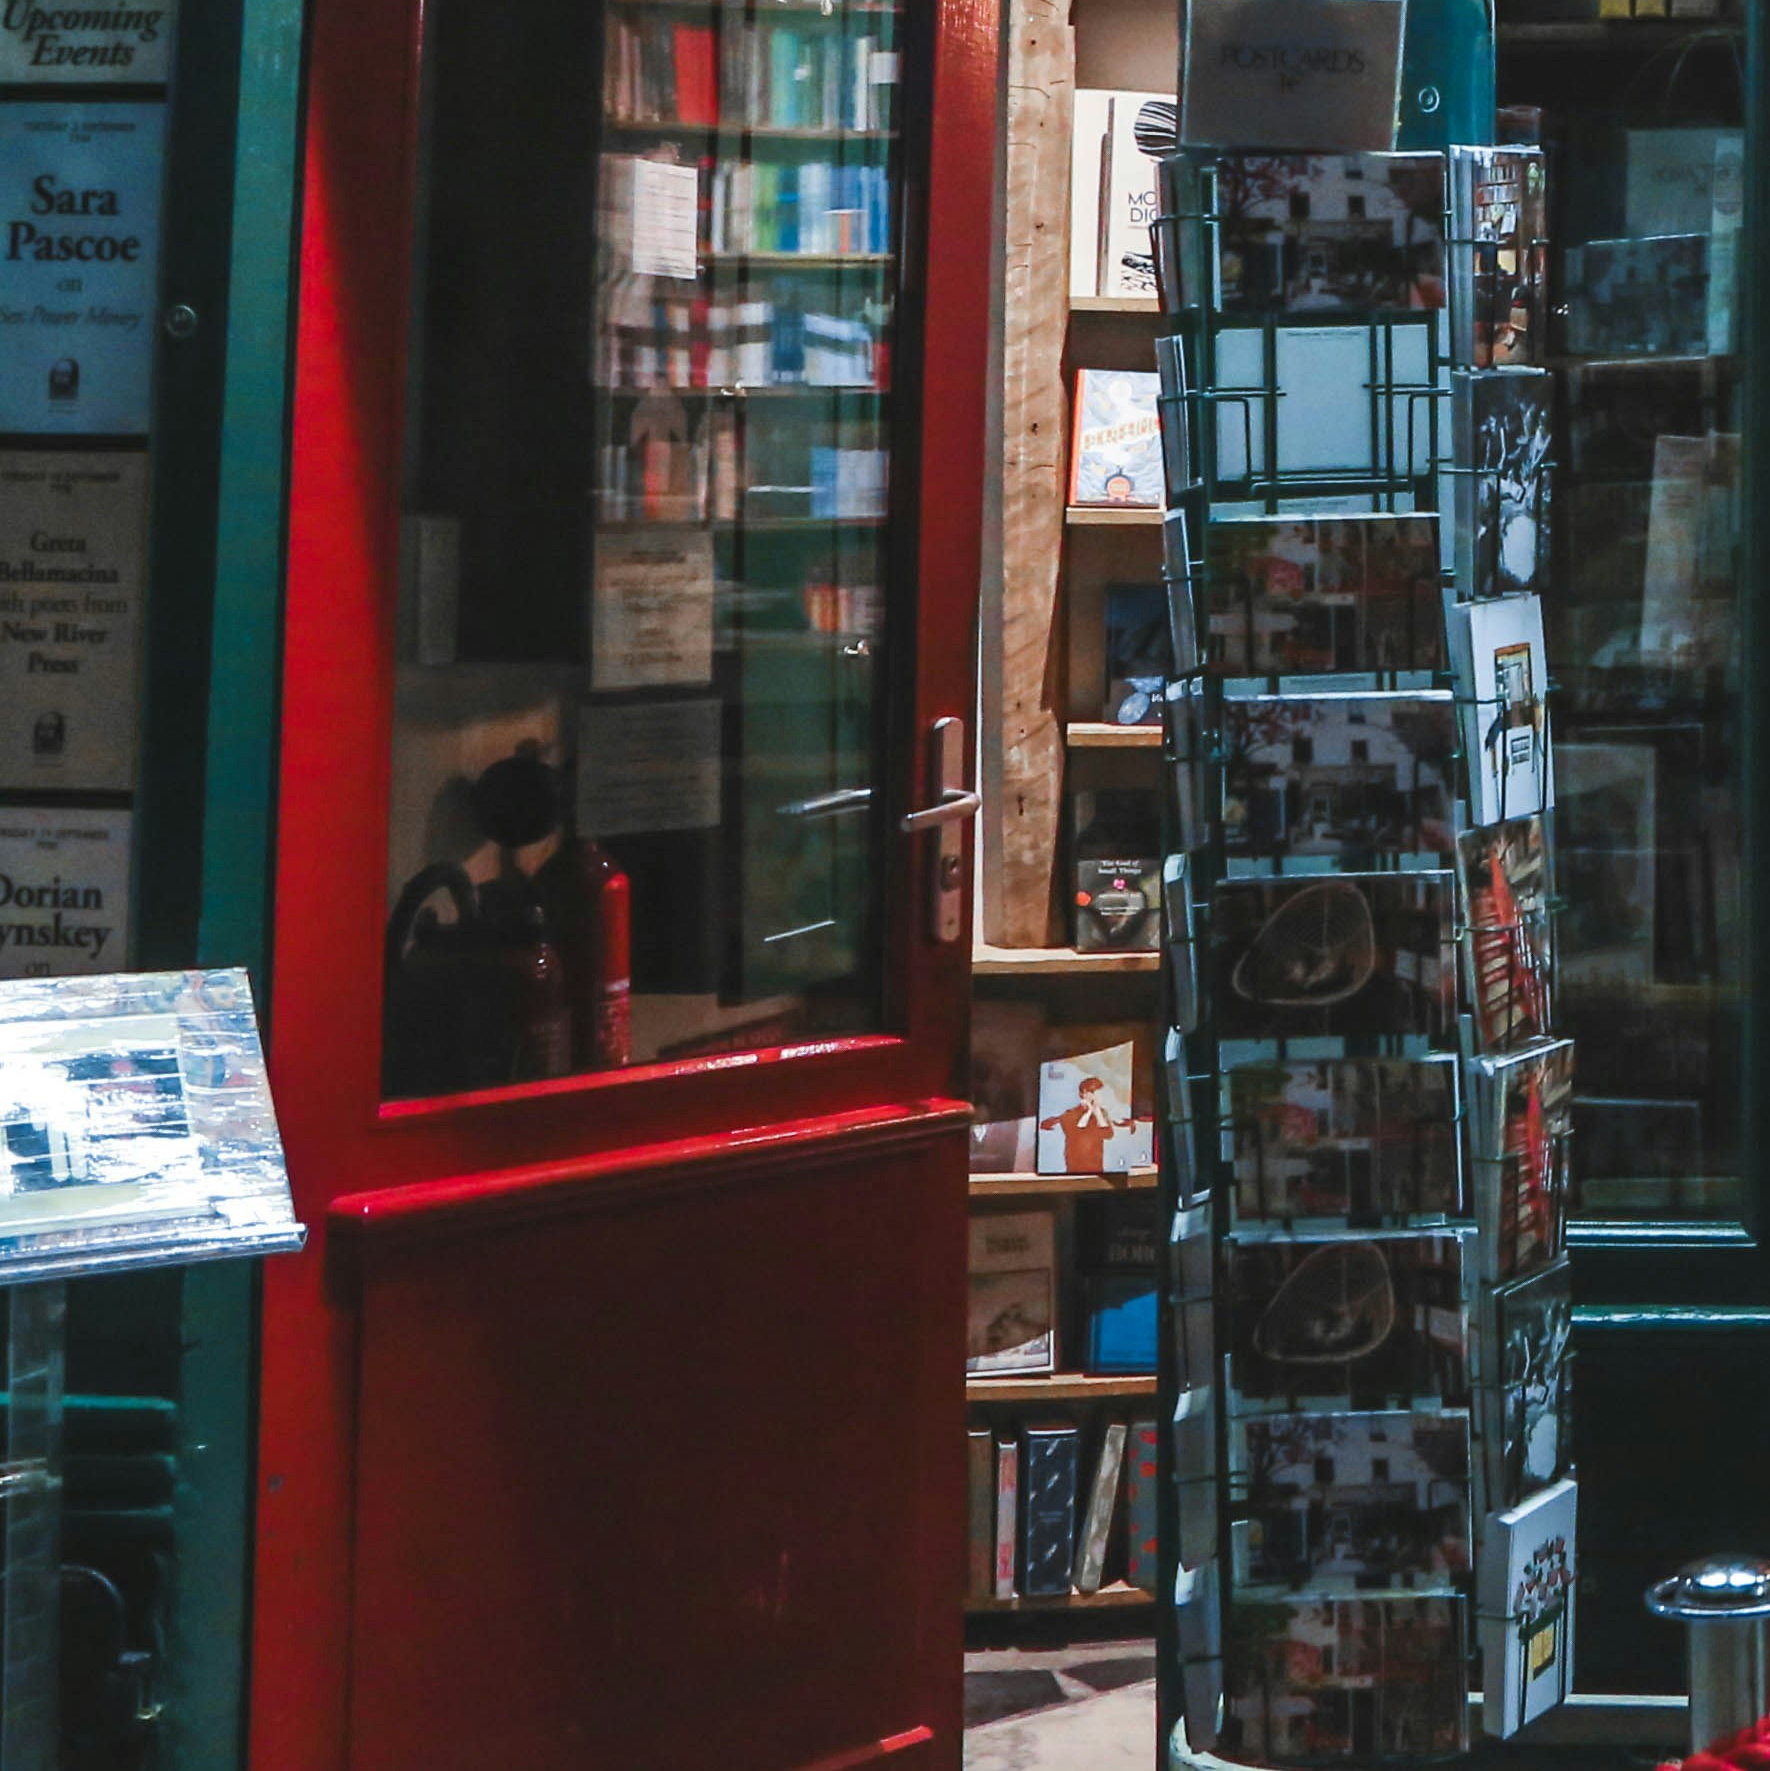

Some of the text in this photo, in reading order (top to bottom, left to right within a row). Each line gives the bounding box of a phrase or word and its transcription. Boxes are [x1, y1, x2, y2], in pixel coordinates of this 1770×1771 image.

[29, 34, 136, 67] Events
[30, 175, 120, 216] Sara
[6, 220, 140, 263] Pascoe
